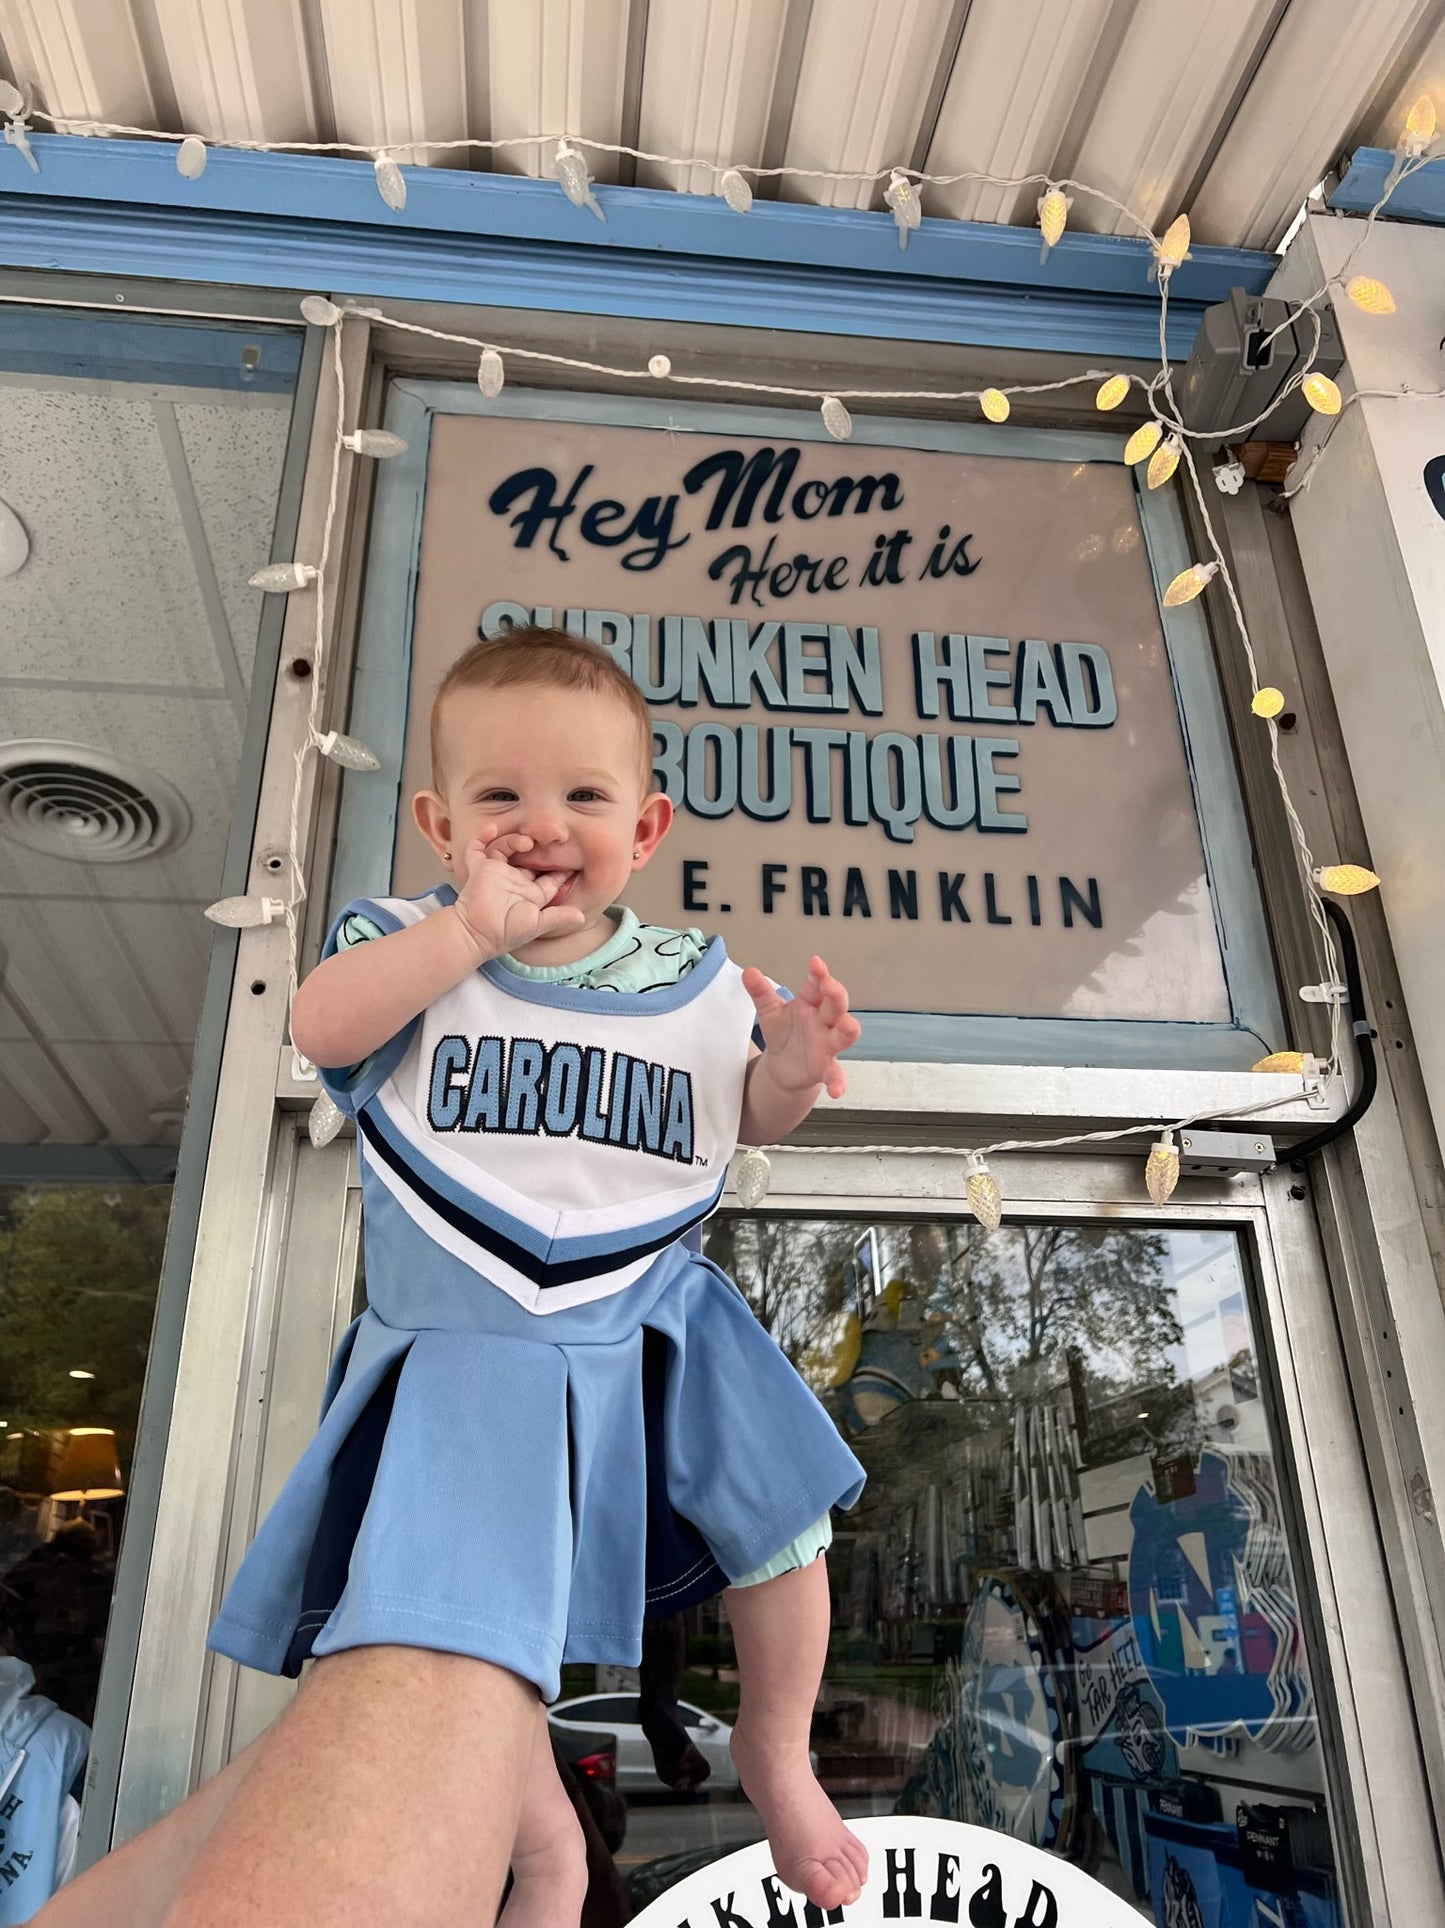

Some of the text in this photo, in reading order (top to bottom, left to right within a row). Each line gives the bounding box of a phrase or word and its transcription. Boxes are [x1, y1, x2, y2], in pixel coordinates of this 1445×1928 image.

[489, 446, 905, 572] Hey Mom
[708, 524, 984, 607] Here it is
[477, 601, 1118, 729] RUNKEN HEAD
[651, 719, 1028, 843] BOUTIQUE
[682, 860, 1104, 929] E. FRANKLIN
[426, 1034, 695, 1165] CAROLINA
[1081, 1675, 1112, 1727] TAR
